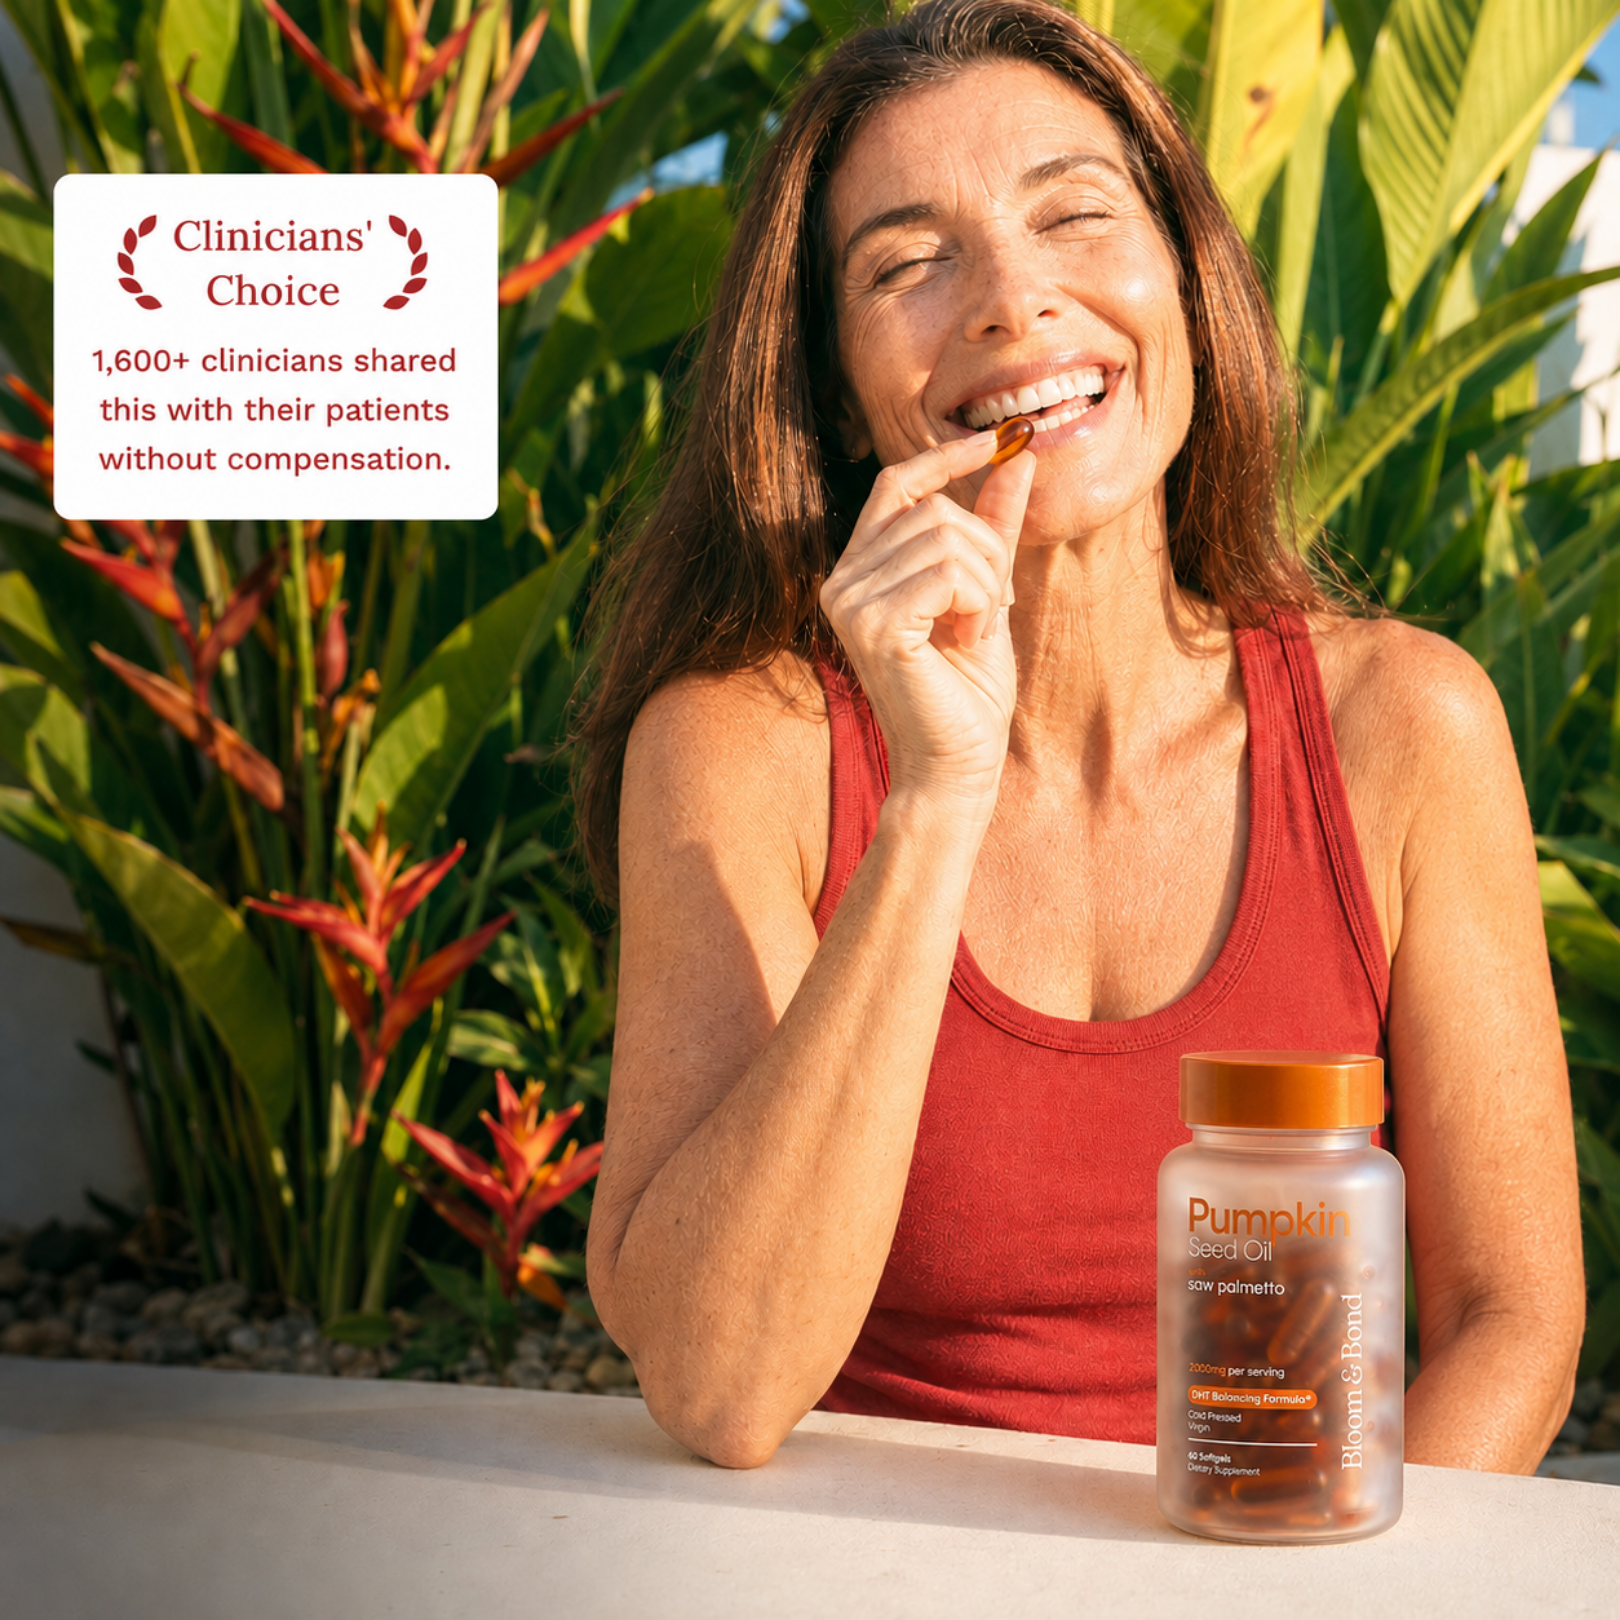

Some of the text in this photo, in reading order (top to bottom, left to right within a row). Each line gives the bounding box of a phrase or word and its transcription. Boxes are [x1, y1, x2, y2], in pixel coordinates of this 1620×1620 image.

[1188, 1196, 1351, 1248] Pumpkin
[1188, 1236, 1272, 1262] Seed Oil
[1187, 1279, 1286, 1296] saw palmetto
[1188, 1362, 1285, 1380] 2000mg per serving
[1341, 1292, 1363, 1470] Bloom & Bond
[1191, 1389, 1210, 1400] DHT
[1211, 1391, 1261, 1406] Balancing
[1187, 1409, 1242, 1423] Cold Pressed
[1199, 1451, 1231, 1465] Softgels
[1214, 1465, 1260, 1477] Supplement
